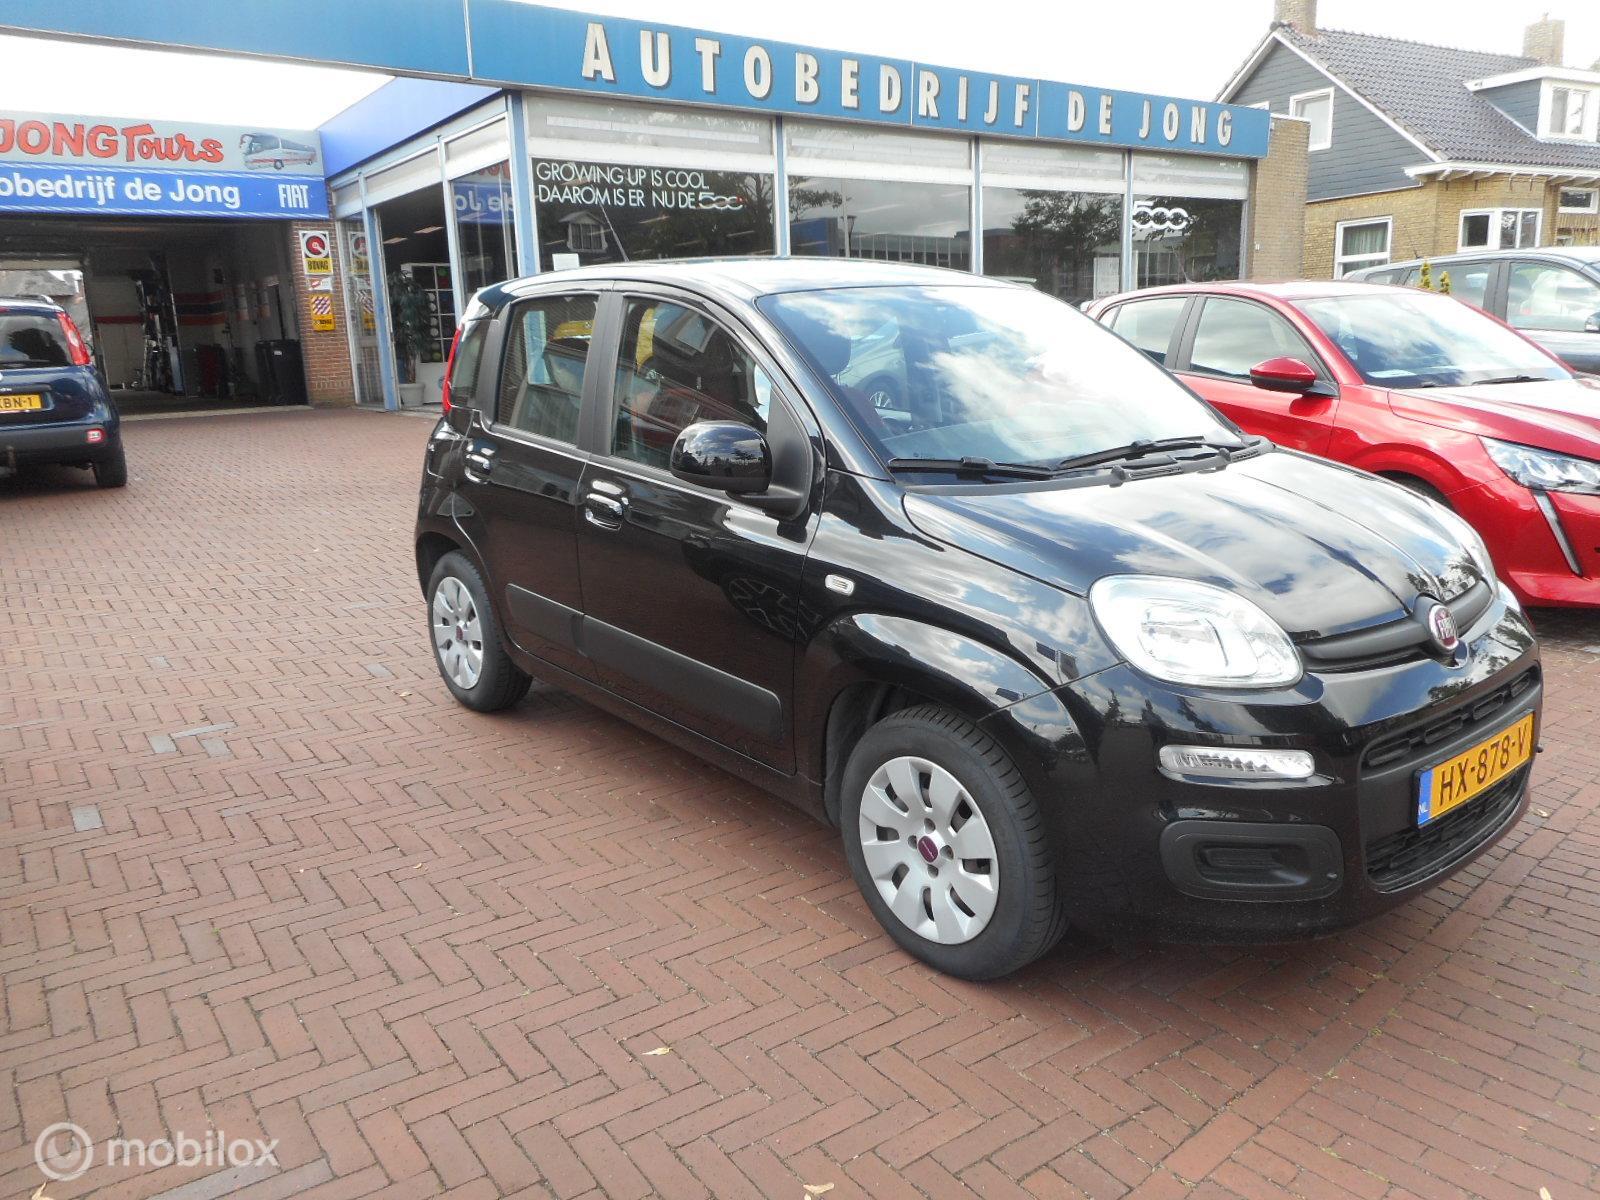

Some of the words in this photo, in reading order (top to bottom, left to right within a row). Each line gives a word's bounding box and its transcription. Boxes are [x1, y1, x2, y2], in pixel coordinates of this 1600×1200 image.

[581, 22, 1030, 127] AUTOBEDRIJF
[1067, 90, 1113, 135] DE
[1138, 101, 1234, 147] JONG
[0, 119, 119, 158] JONG
[121, 124, 225, 163] Tours
[536, 162, 624, 185] GROWING
[627, 168, 646, 186] UP
[651, 170, 663, 187] IS
[124, 178, 162, 201] de
[169, 179, 241, 209] Jong
[277, 184, 310, 209] FIAT
[538, 184, 610, 206] DAAROM
[613, 189, 626, 206] IS
[628, 190, 645, 207] ER
[652, 191, 676, 208] NU
[678, 192, 696, 209] DE
[1133, 200, 1189, 230] 500
[1438, 722, 1529, 807] HX-878-V
